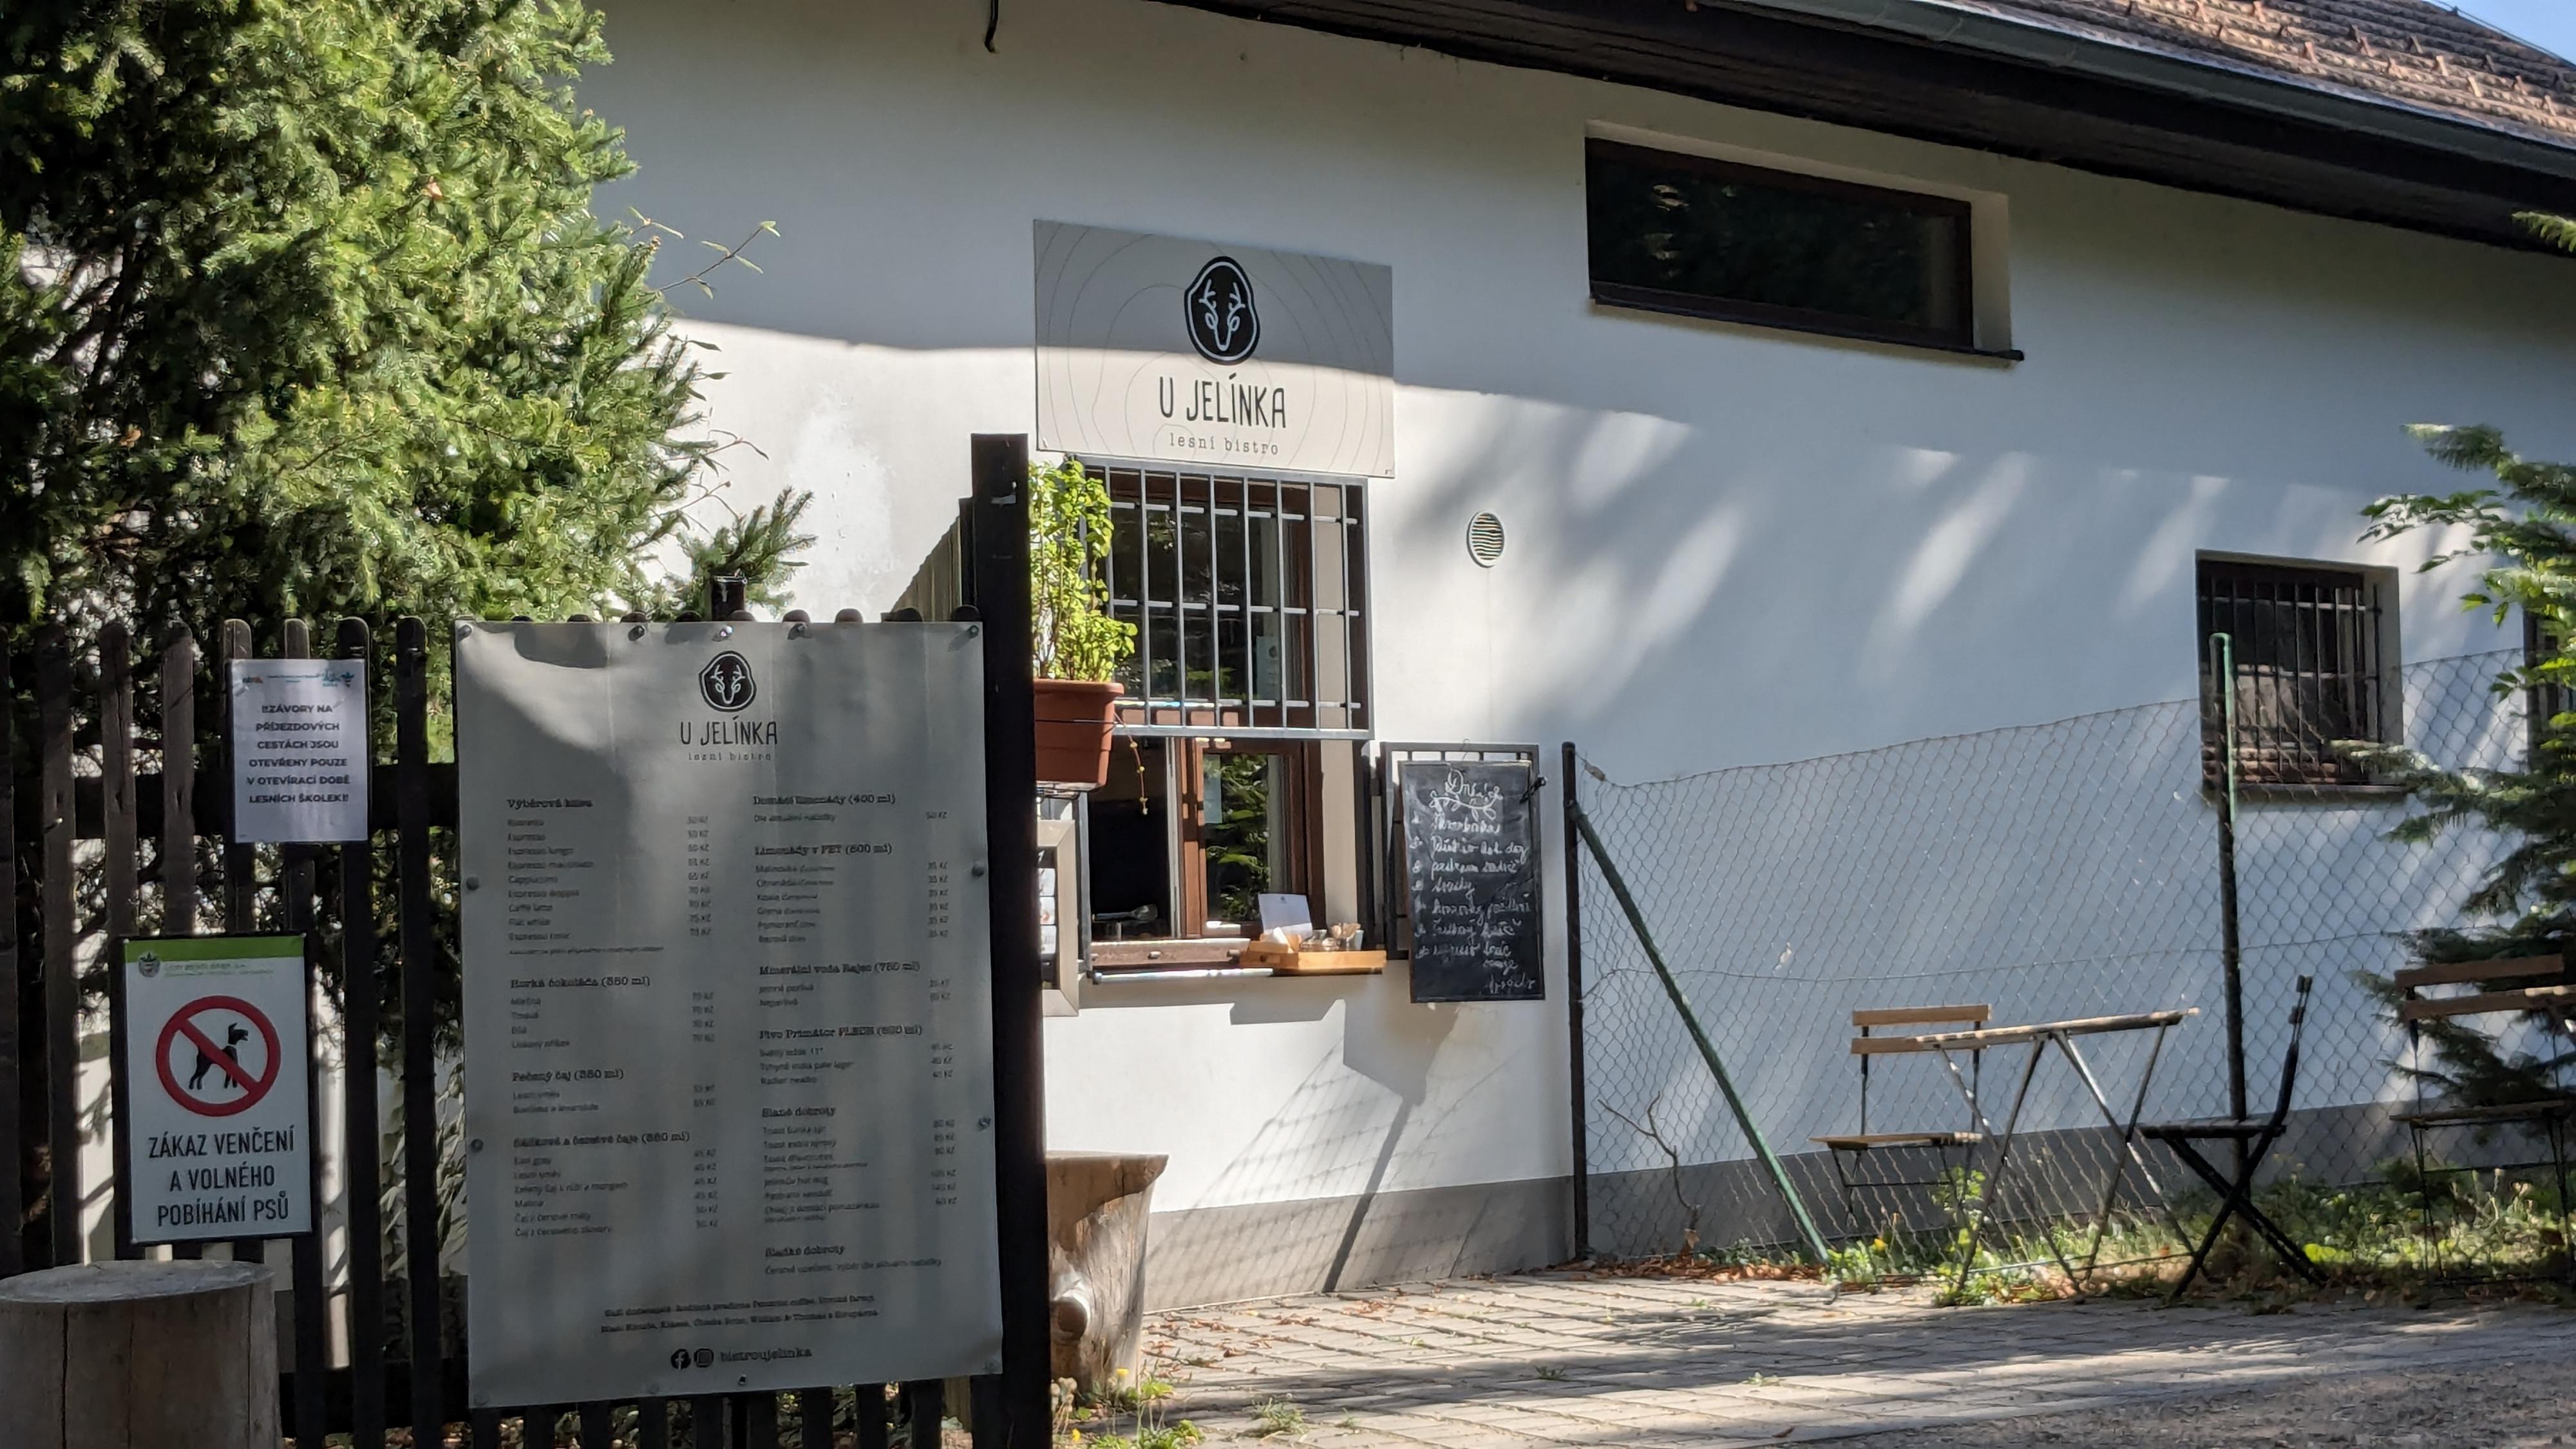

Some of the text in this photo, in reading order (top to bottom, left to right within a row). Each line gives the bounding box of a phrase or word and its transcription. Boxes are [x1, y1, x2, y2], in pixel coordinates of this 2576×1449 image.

[1159, 372, 1287, 429] U JELÍNKA
[1170, 432, 1279, 456] lesní bistro
[317, 705, 333, 713] NA
[256, 721, 340, 732] PŘÍJEZDOVÝCH
[680, 715, 778, 746] U JELÍNKA
[258, 739, 339, 749] CESTÁCH JSOU
[249, 756, 348, 767] OTEVŘENY POUZE
[247, 774, 350, 785] V OTEVÍRACÍ DOBĚ
[249, 792, 296, 803] LESNÍCH
[149, 1125, 294, 1159] ZÁKAZ VENČENÍ
[169, 1161, 274, 1191] A VOLNÉHO
[158, 1191, 289, 1226] POBÍHÁNÍ PSŮ
